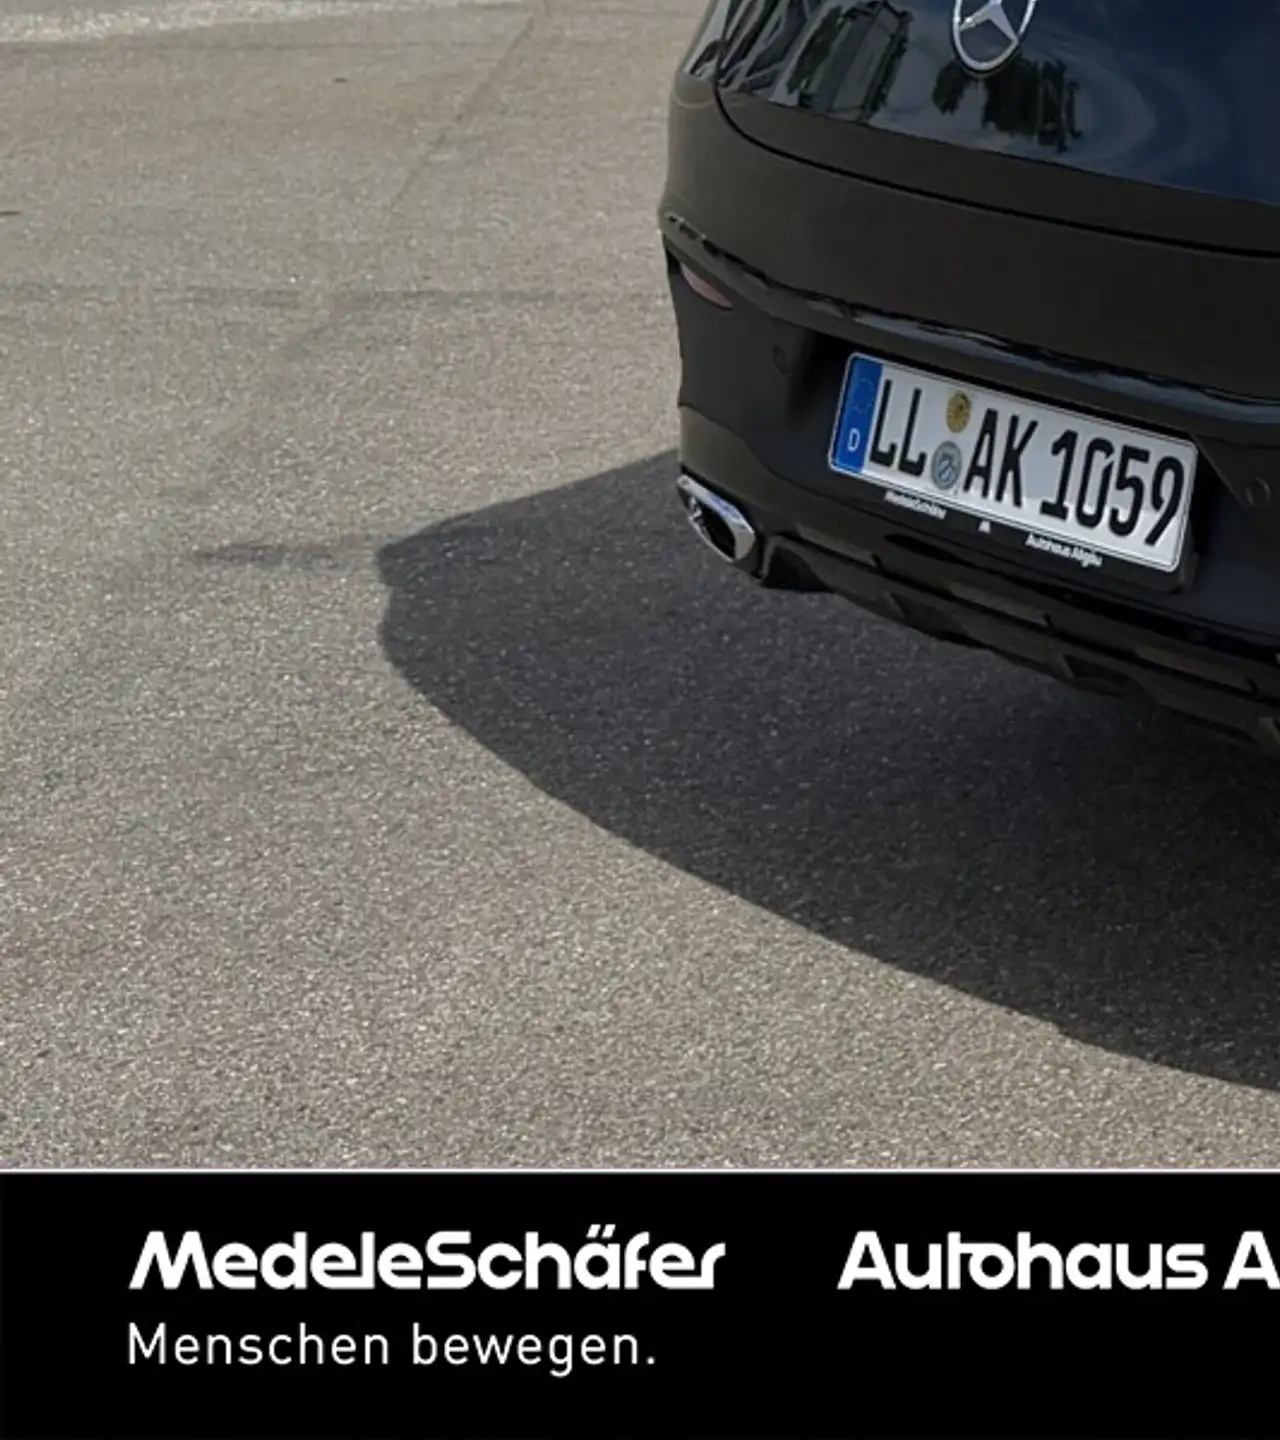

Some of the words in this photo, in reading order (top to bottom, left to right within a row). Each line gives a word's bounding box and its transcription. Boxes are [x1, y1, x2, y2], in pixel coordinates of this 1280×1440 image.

[847, 428, 861, 452] D
[869, 378, 928, 477] LL
[963, 407, 1039, 508] AK
[1039, 428, 1186, 548] 1059
